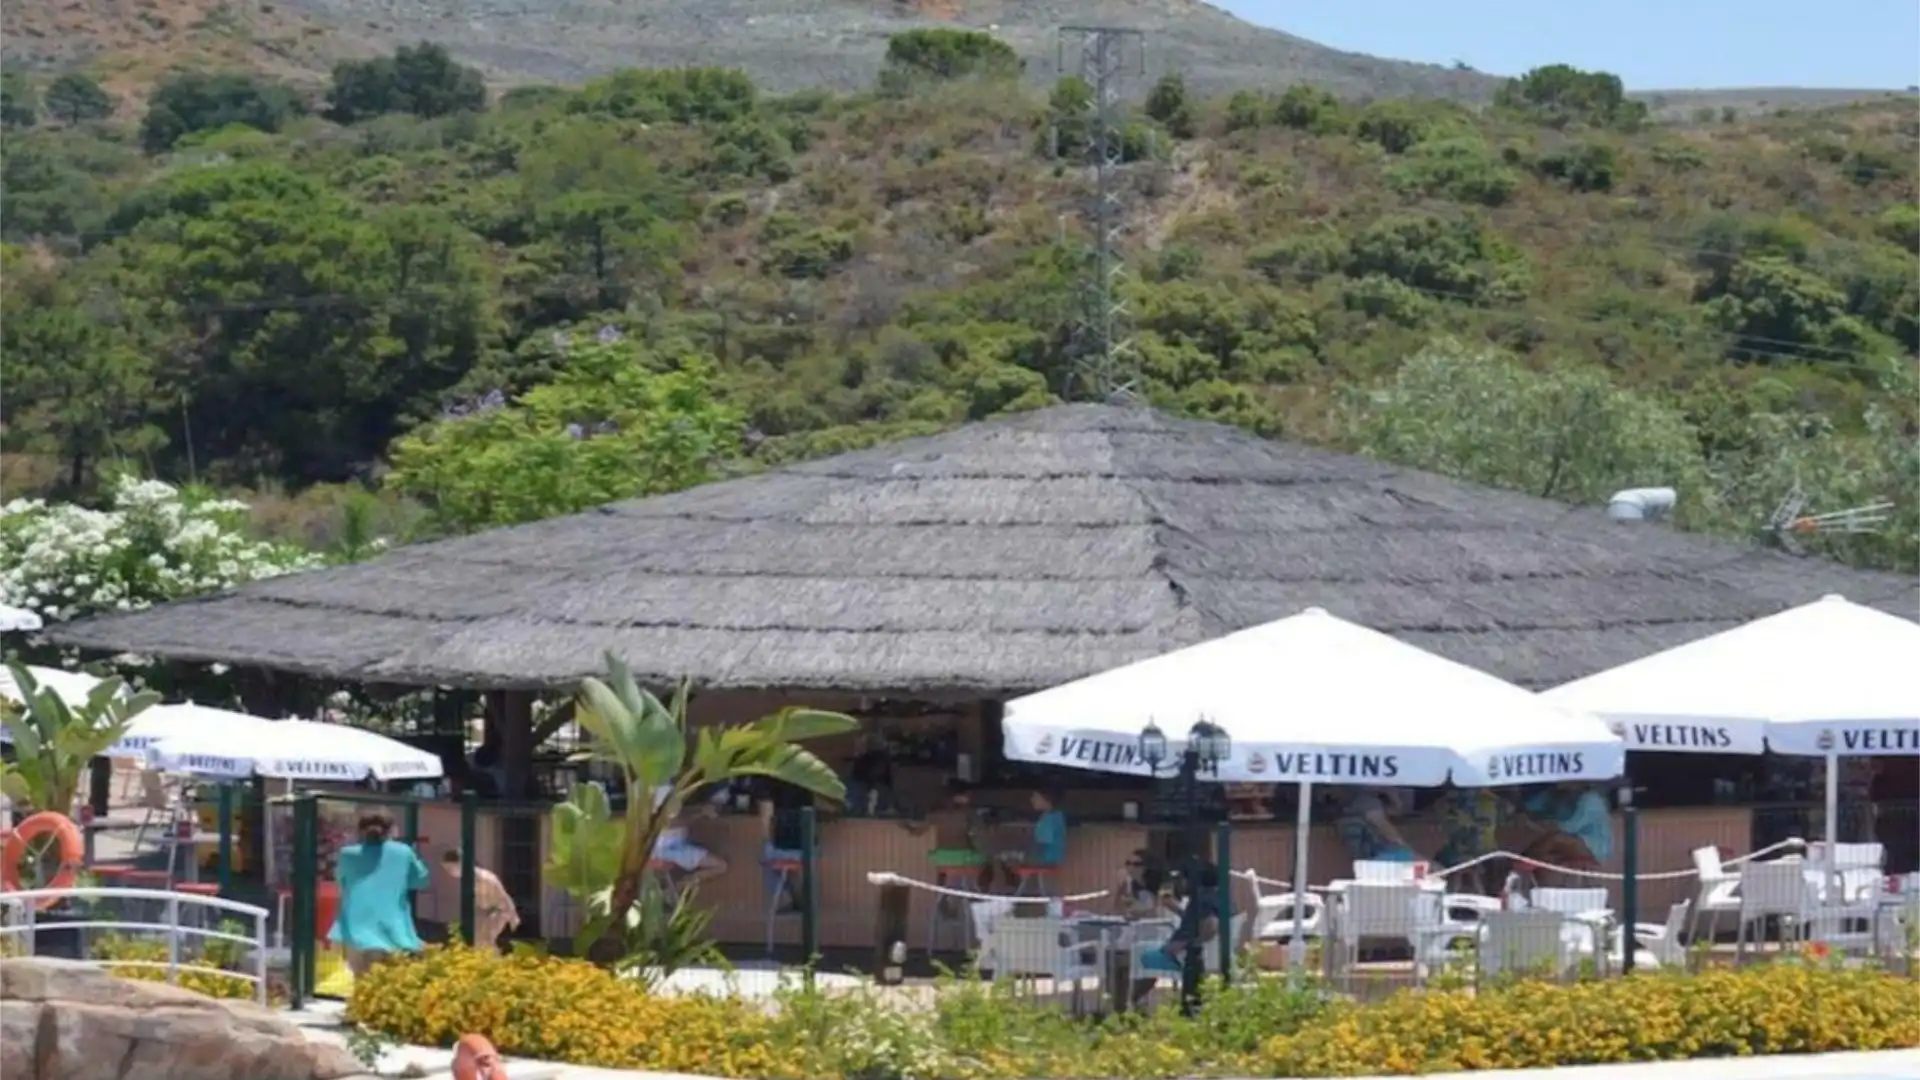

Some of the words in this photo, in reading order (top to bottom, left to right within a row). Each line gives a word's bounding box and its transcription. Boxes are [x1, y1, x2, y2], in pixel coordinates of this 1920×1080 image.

[1634, 723, 1732, 748] VELTINS
[286, 760, 349, 774] VELTINS
[1275, 752, 1399, 778] VELTINS
[1502, 751, 1584, 777] VELTINS
